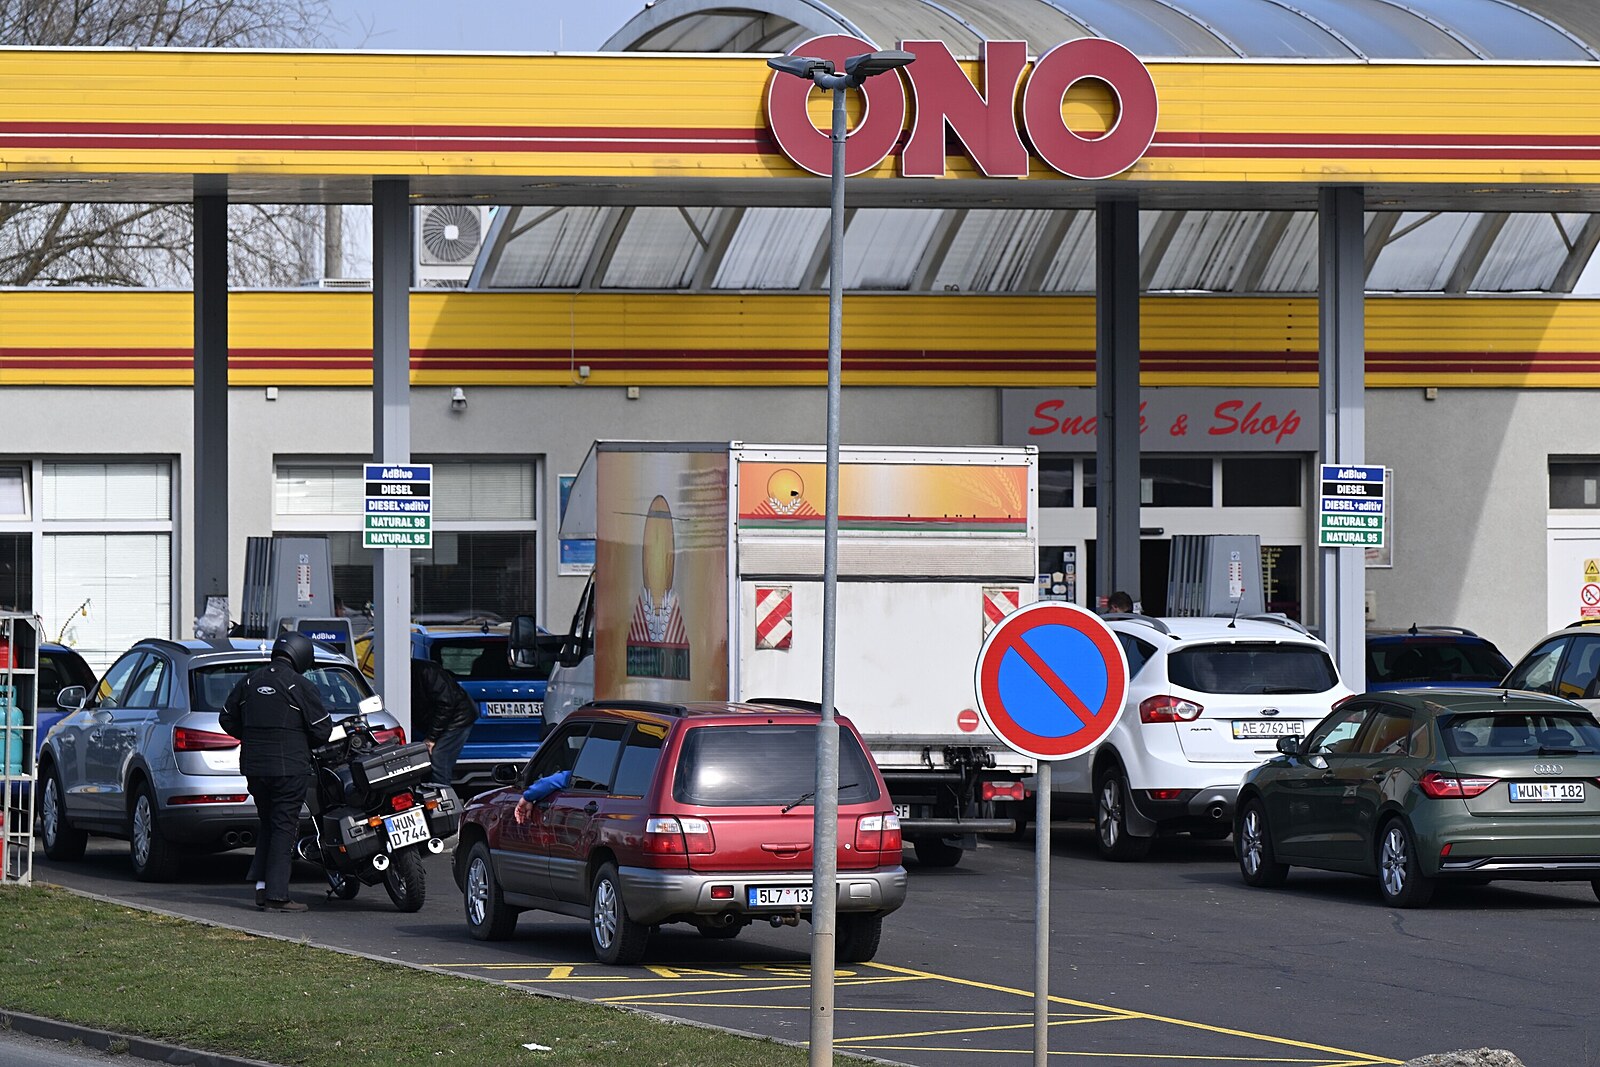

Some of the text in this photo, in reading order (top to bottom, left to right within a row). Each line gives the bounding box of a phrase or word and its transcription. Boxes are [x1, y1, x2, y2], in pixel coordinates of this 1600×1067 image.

[766, 35, 1159, 180] ONO
[1169, 413, 1188, 436] &
[1208, 399, 1301, 444] Shop
[381, 468, 413, 479] AdBlue
[1337, 469, 1367, 479] AdBlue
[381, 484, 413, 495] DIESEL
[1336, 485, 1367, 495] DIESEL
[368, 500, 429, 512] DIESEL+aditiv
[1324, 500, 1382, 511] DIESEL+aditiv
[370, 516, 426, 528] NATURAL 98
[1326, 516, 1378, 527] NATURAL 98
[370, 533, 426, 544] NATURAL 95
[1326, 532, 1378, 543] NATURAL 95
[311, 632, 336, 640] AdBlue
[487, 703, 506, 714] NEW
[514, 704, 526, 714] AR
[1242, 722, 1302, 734] AE 2762 HE
[1518, 785, 1583, 797] WUN T 182
[392, 814, 416, 831] WUN
[392, 826, 427, 847] D 744
[759, 889, 783, 904] 5L7
